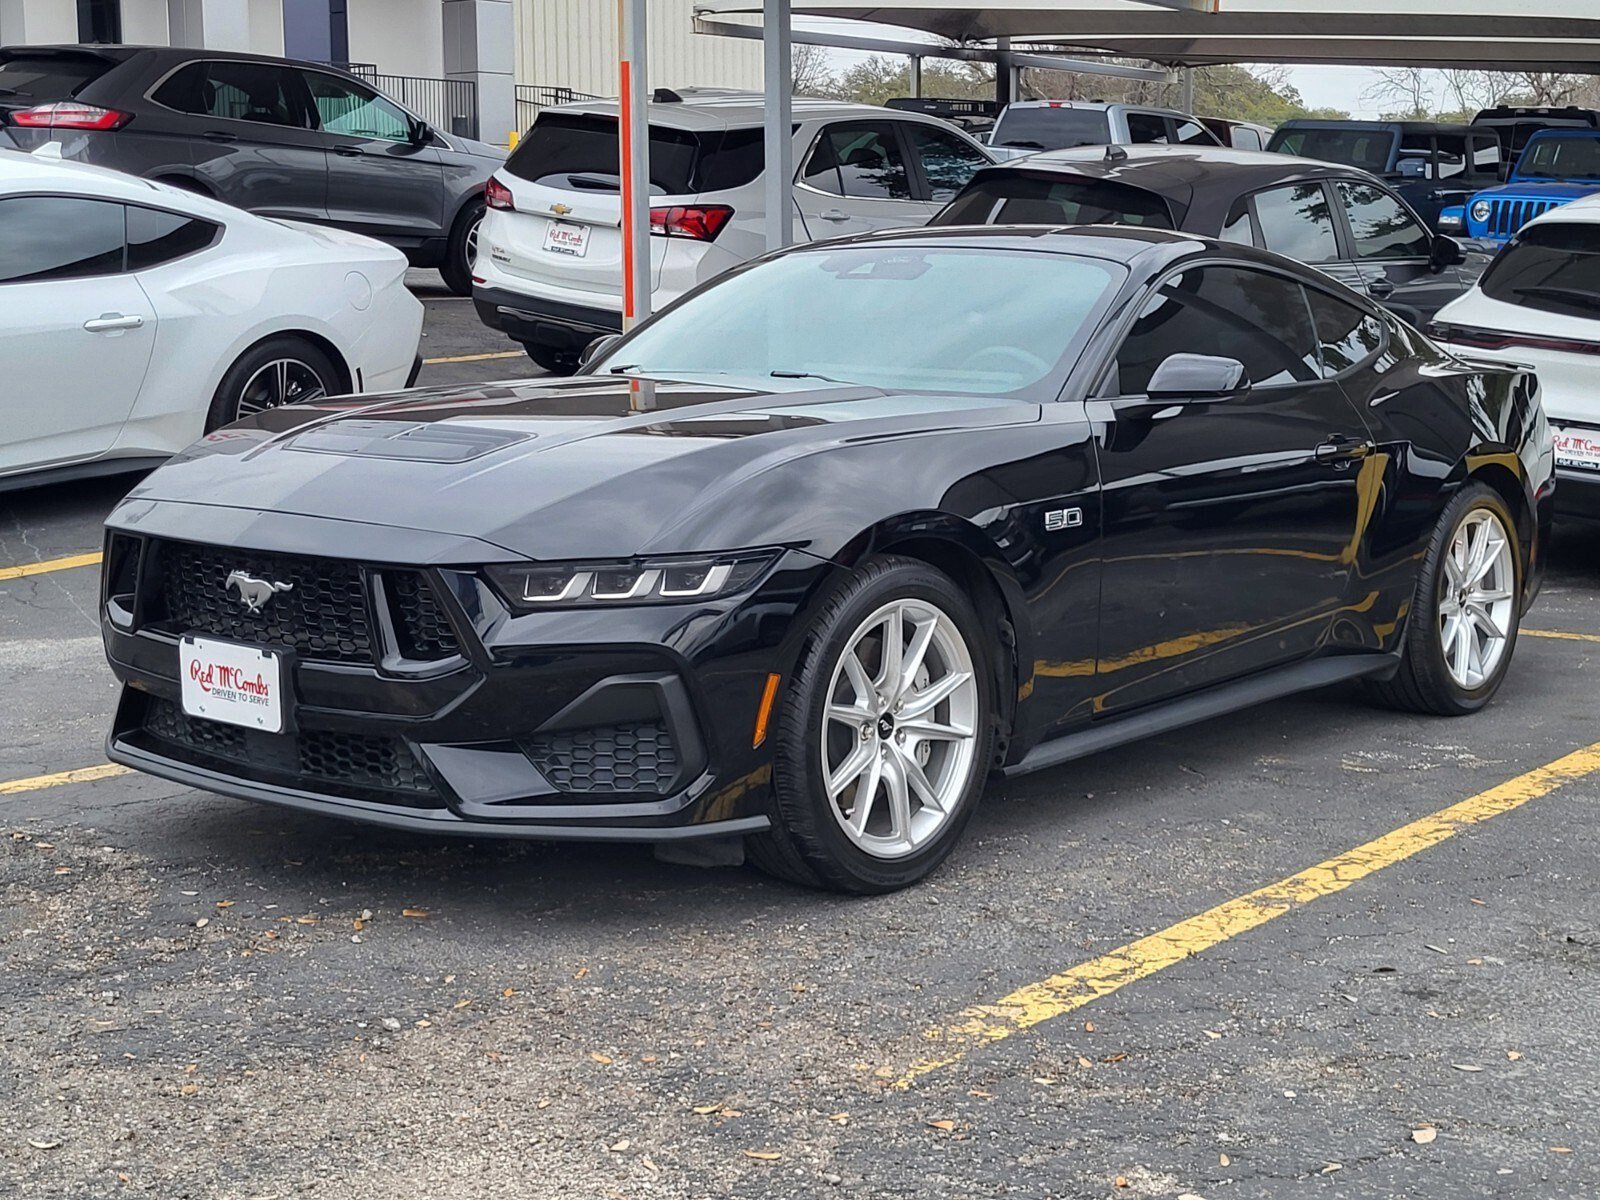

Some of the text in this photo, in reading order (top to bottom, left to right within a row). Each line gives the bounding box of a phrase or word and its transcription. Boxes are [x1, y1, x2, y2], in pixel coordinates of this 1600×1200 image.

[190, 659, 269, 697] Red McCombs
[211, 687, 270, 707] DRIVEN TO SERVE
